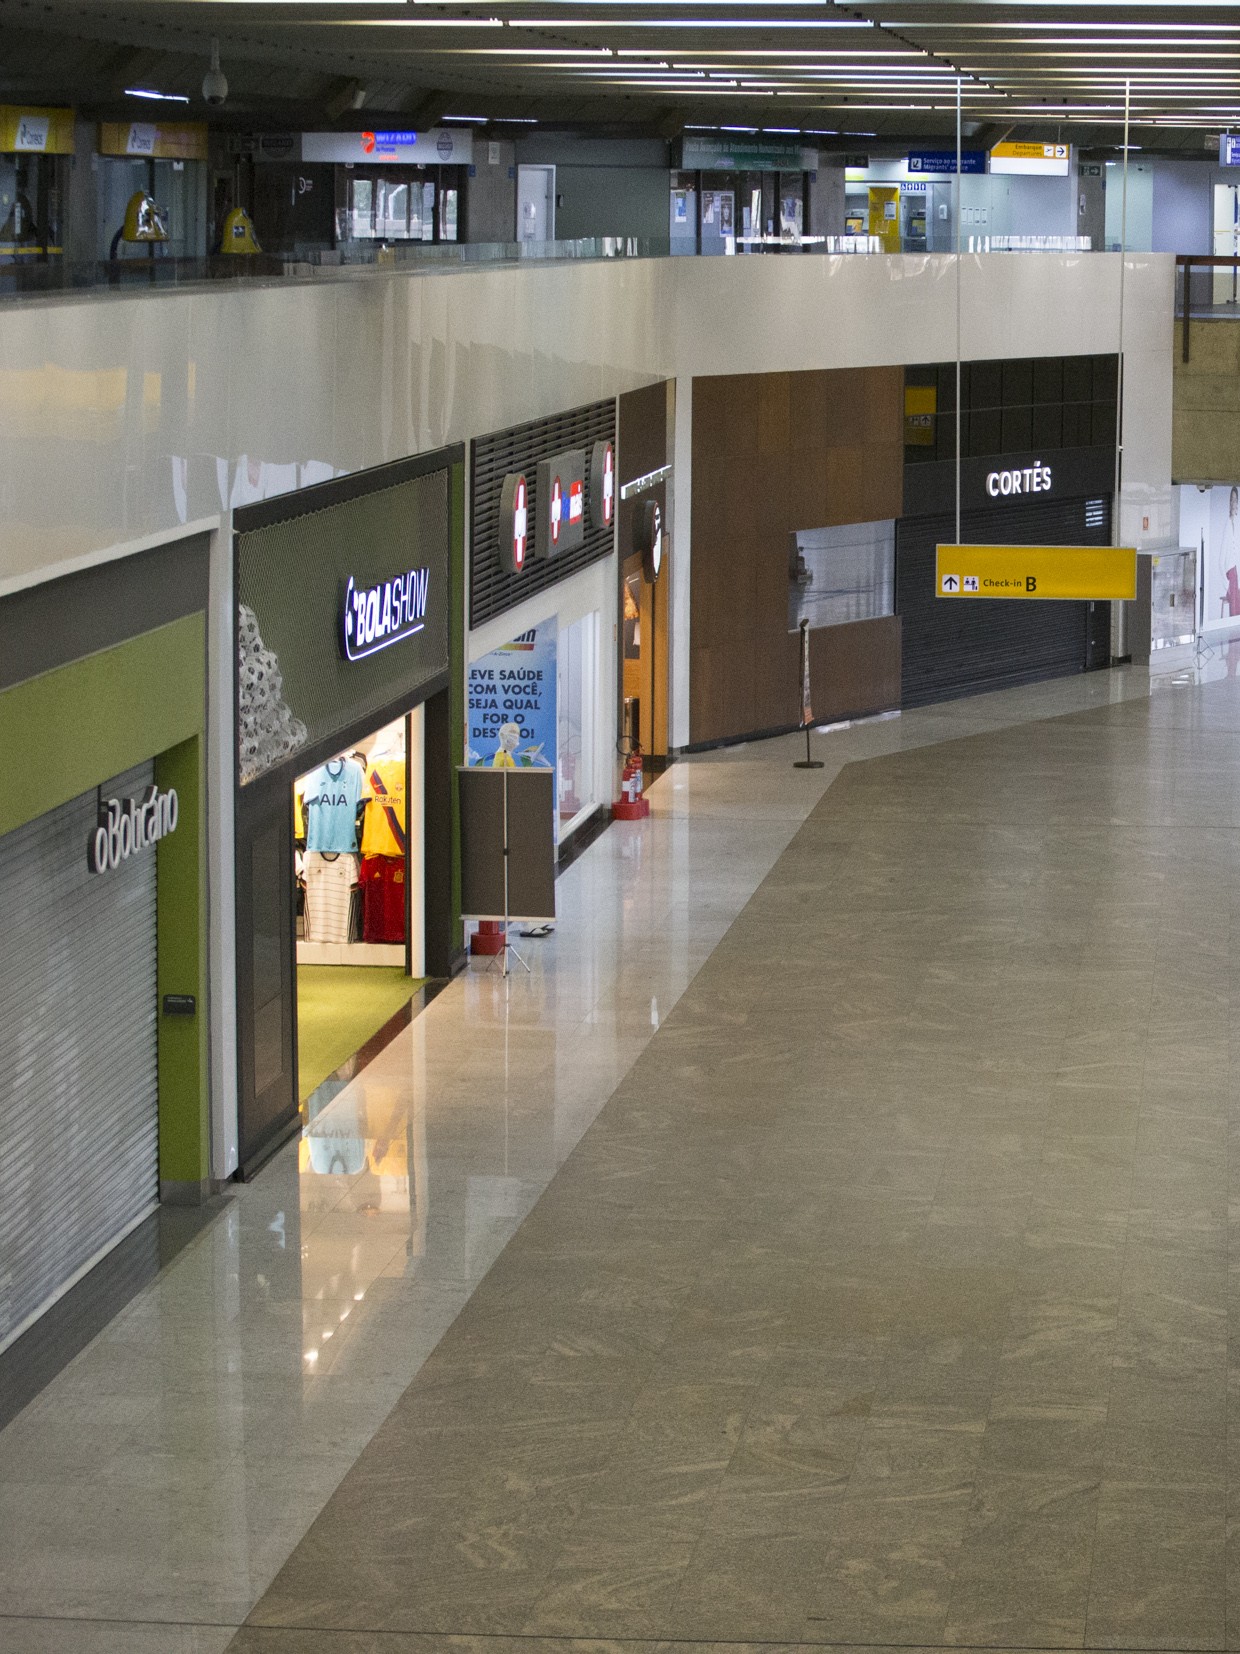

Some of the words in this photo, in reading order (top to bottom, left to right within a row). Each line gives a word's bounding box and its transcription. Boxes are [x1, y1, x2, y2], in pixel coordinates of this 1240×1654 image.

[923, 158, 943, 166] Serviço
[987, 461, 1051, 496] CORTÉS
[983, 578, 1022, 588] Check-in
[1025, 576, 1037, 592] B
[356, 568, 430, 647] BOLASHOW
[499, 667, 543, 681] SAÚDE
[501, 682, 543, 697] VOCÊ,
[468, 698, 498, 709] SEJA
[503, 698, 541, 710] QUAL
[482, 713, 509, 723] FOR
[514, 713, 525, 724] O
[320, 794, 348, 806] AIA
